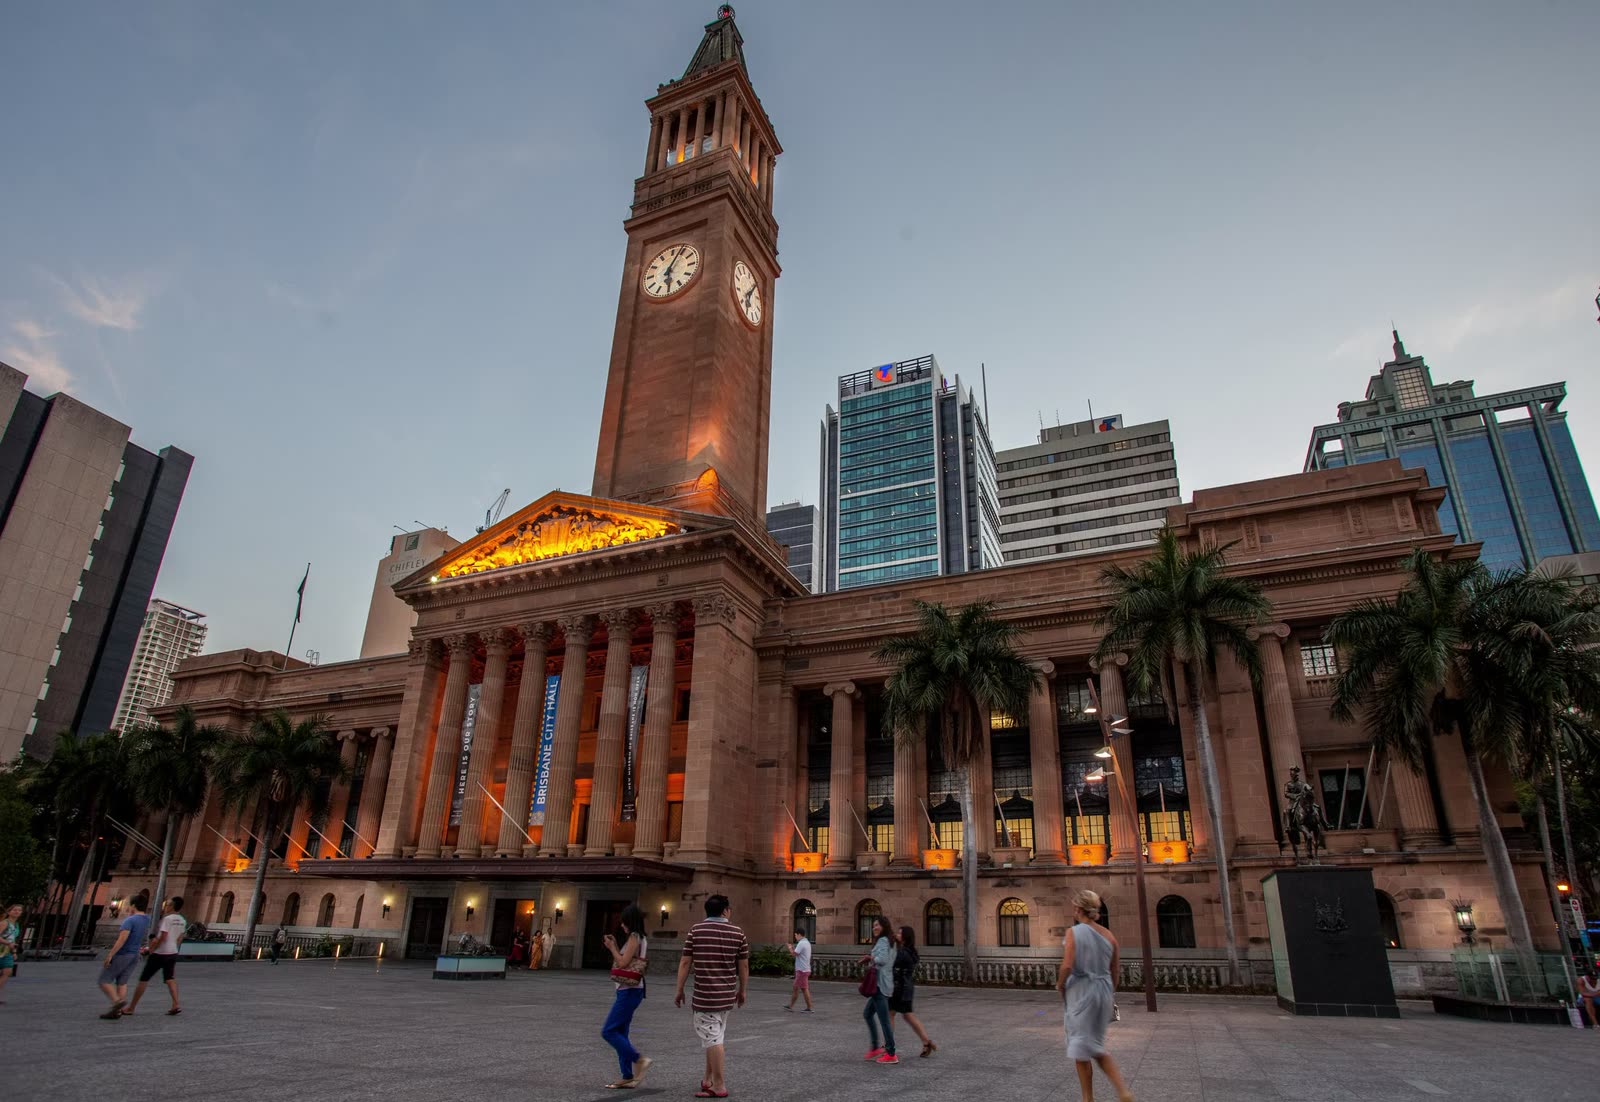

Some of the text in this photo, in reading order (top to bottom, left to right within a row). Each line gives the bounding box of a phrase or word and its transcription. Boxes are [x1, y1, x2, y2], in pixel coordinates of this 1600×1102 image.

[390, 558, 426, 573] CHIFLEY
[458, 697, 476, 794] HERE IS OUR STORY
[536, 680, 559, 805] BRISBANE CITY HALL
